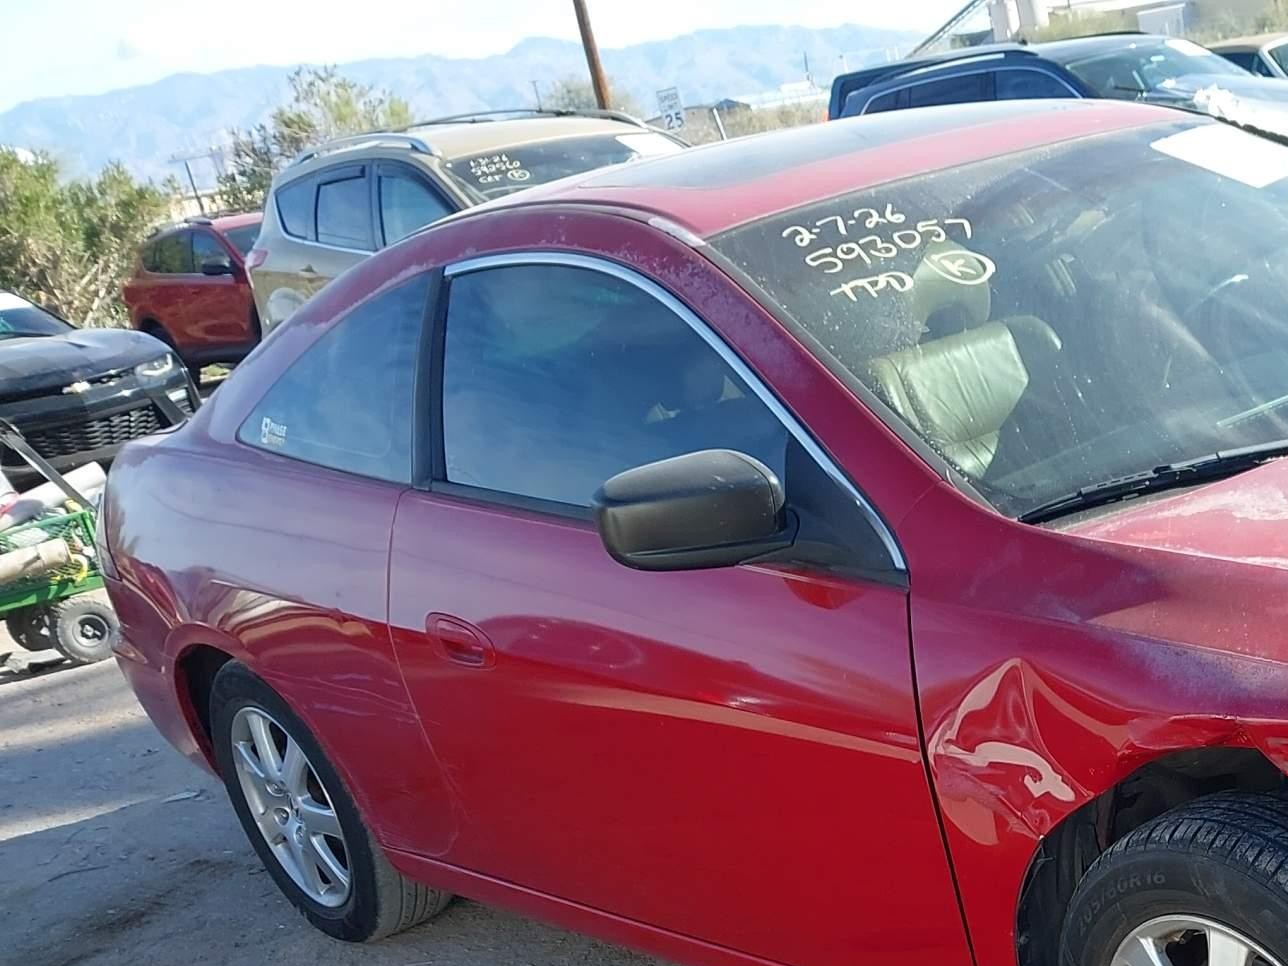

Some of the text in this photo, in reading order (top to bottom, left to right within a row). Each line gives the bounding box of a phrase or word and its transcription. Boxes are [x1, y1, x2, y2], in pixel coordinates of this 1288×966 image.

[665, 112, 684, 130] 25
[782, 203, 906, 247] 2-7-26
[805, 219, 972, 273] 593057
